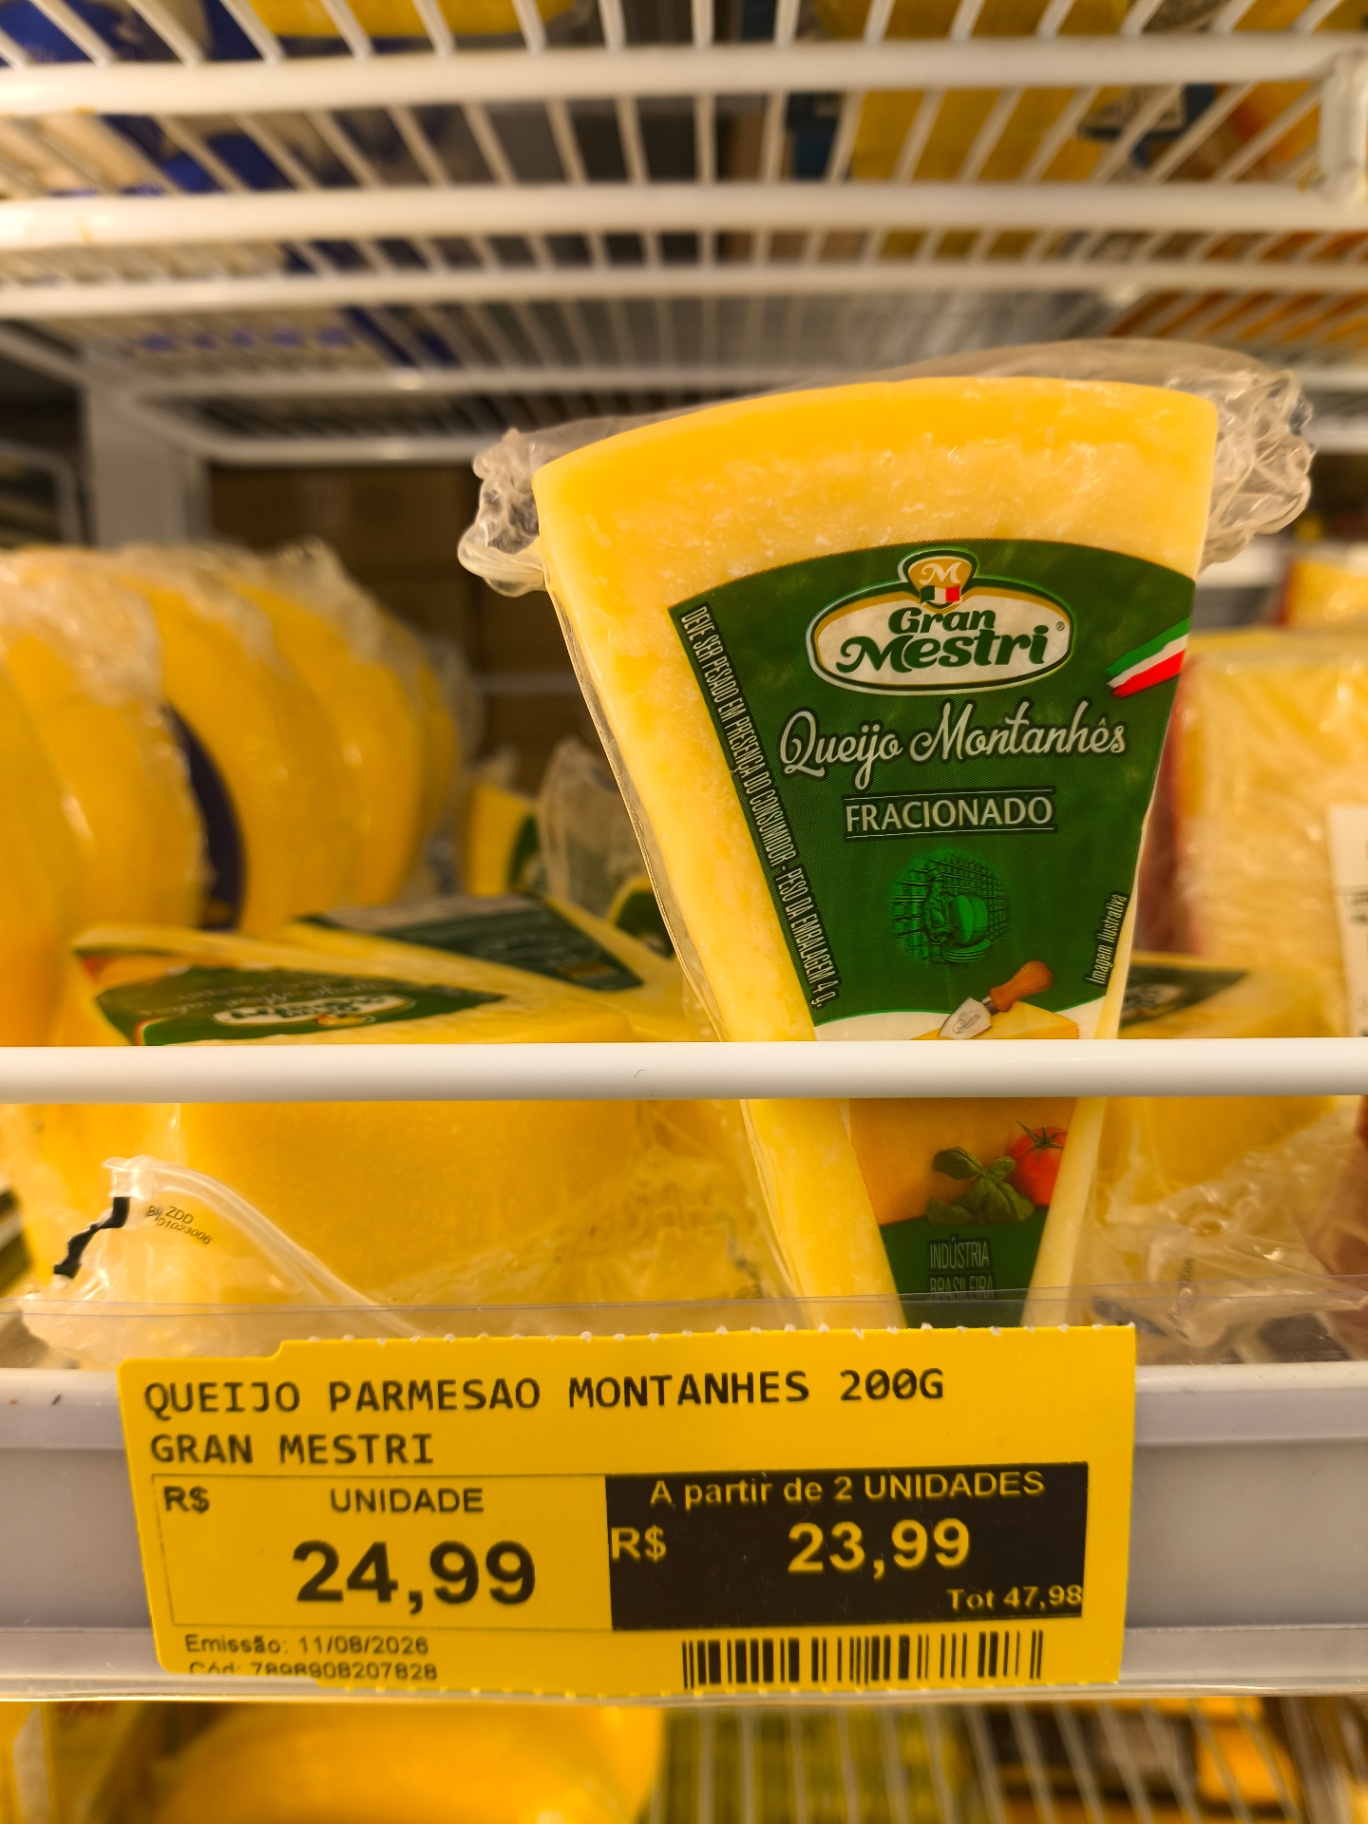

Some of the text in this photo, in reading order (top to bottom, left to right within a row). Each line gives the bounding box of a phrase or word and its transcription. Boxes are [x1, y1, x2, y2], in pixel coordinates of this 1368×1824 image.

[681, 606, 715, 641] DEVE
[888, 606, 996, 635] Gran
[693, 634, 724, 662] SER
[835, 624, 1050, 673] Mestri
[702, 655, 740, 703] PESADO
[717, 697, 747, 723] EM
[724, 715, 766, 779] PRESENÇA
[780, 701, 1126, 790] Queijo Montanhês
[743, 771, 773, 794] DO
[749, 788, 796, 867] CONSUMIDOR
[845, 797, 1051, 832] FRACIONADO
[776, 867, 809, 902] PESO
[785, 896, 815, 920] DA
[790, 913, 836, 984] EMBALAGEM
[1085, 944, 1115, 985] Imagem
[811, 979, 839, 994] 4
[930, 1236, 990, 1269] INDÚSTRIA
[929, 1274, 995, 1301] BRASILEIRA
[144, 1368, 943, 1420] QUEIJO PARMESAO MONTANHES 200G
[151, 1433, 434, 1464] GRAN MESTRI
[163, 1486, 484, 1514] R$ UNIDADE
[650, 1471, 1045, 1511] A partir de 2 UNIDADES
[611, 1518, 970, 1580] R$ 23,99
[292, 1540, 536, 1615] 24,99
[947, 1584, 1083, 1611] Tot 47,98
[185, 1634, 429, 1655] Emissão: 11/08/2026
